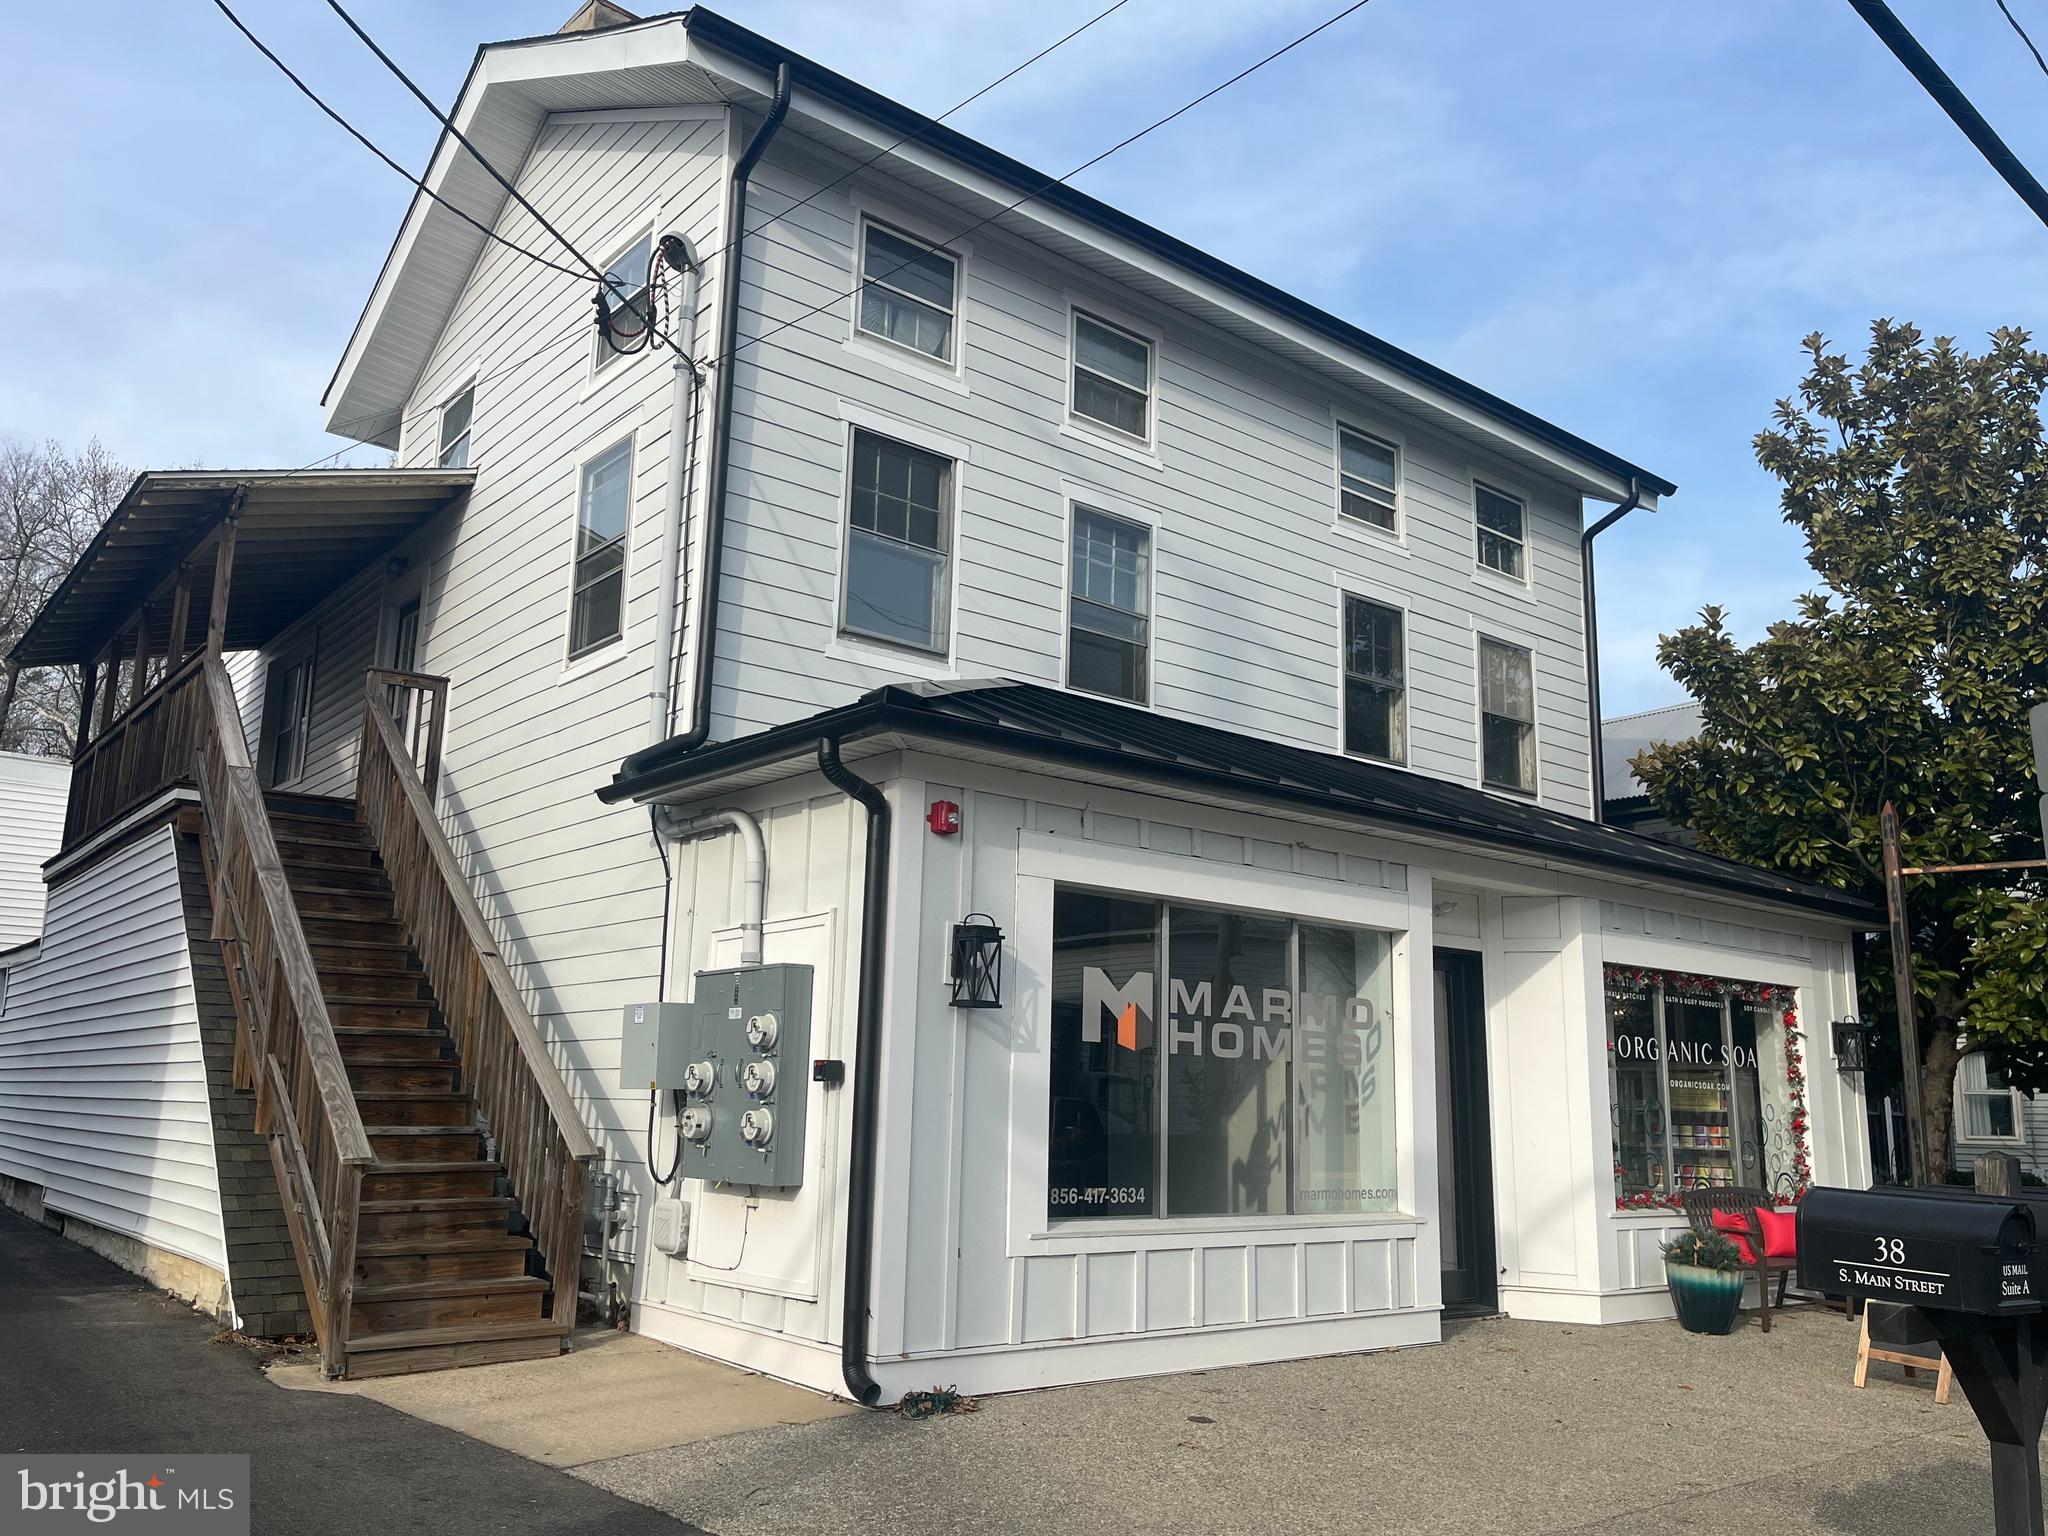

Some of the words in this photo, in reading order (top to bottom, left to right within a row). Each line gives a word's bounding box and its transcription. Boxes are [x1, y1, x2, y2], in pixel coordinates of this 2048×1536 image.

[1170, 978, 1374, 1030] MARMO
[1665, 995, 1679, 1003] BATH
[1698, 999, 1724, 1009] PRODUCTS
[1169, 1020, 1363, 1067] HOMES
[1618, 1034, 1713, 1065] ORGANIC
[1721, 1044, 1758, 1069] SOA
[1670, 1079, 1731, 1091] ORGANICSOAK.COM
[1050, 1187, 1146, 1205] 856-417-3634
[1300, 1186, 1398, 1201] marmohomes.com
[1873, 1236, 1906, 1265] 38
[2002, 1264, 2012, 1276] US
[2012, 1263, 2029, 1276] MAIL
[1839, 1268, 1852, 1283] S.
[1854, 1270, 1891, 1288] MAIN
[1894, 1275, 1945, 1295] STREET
[2001, 1280, 2022, 1296] Suite
[2022, 1280, 2031, 1295] A
